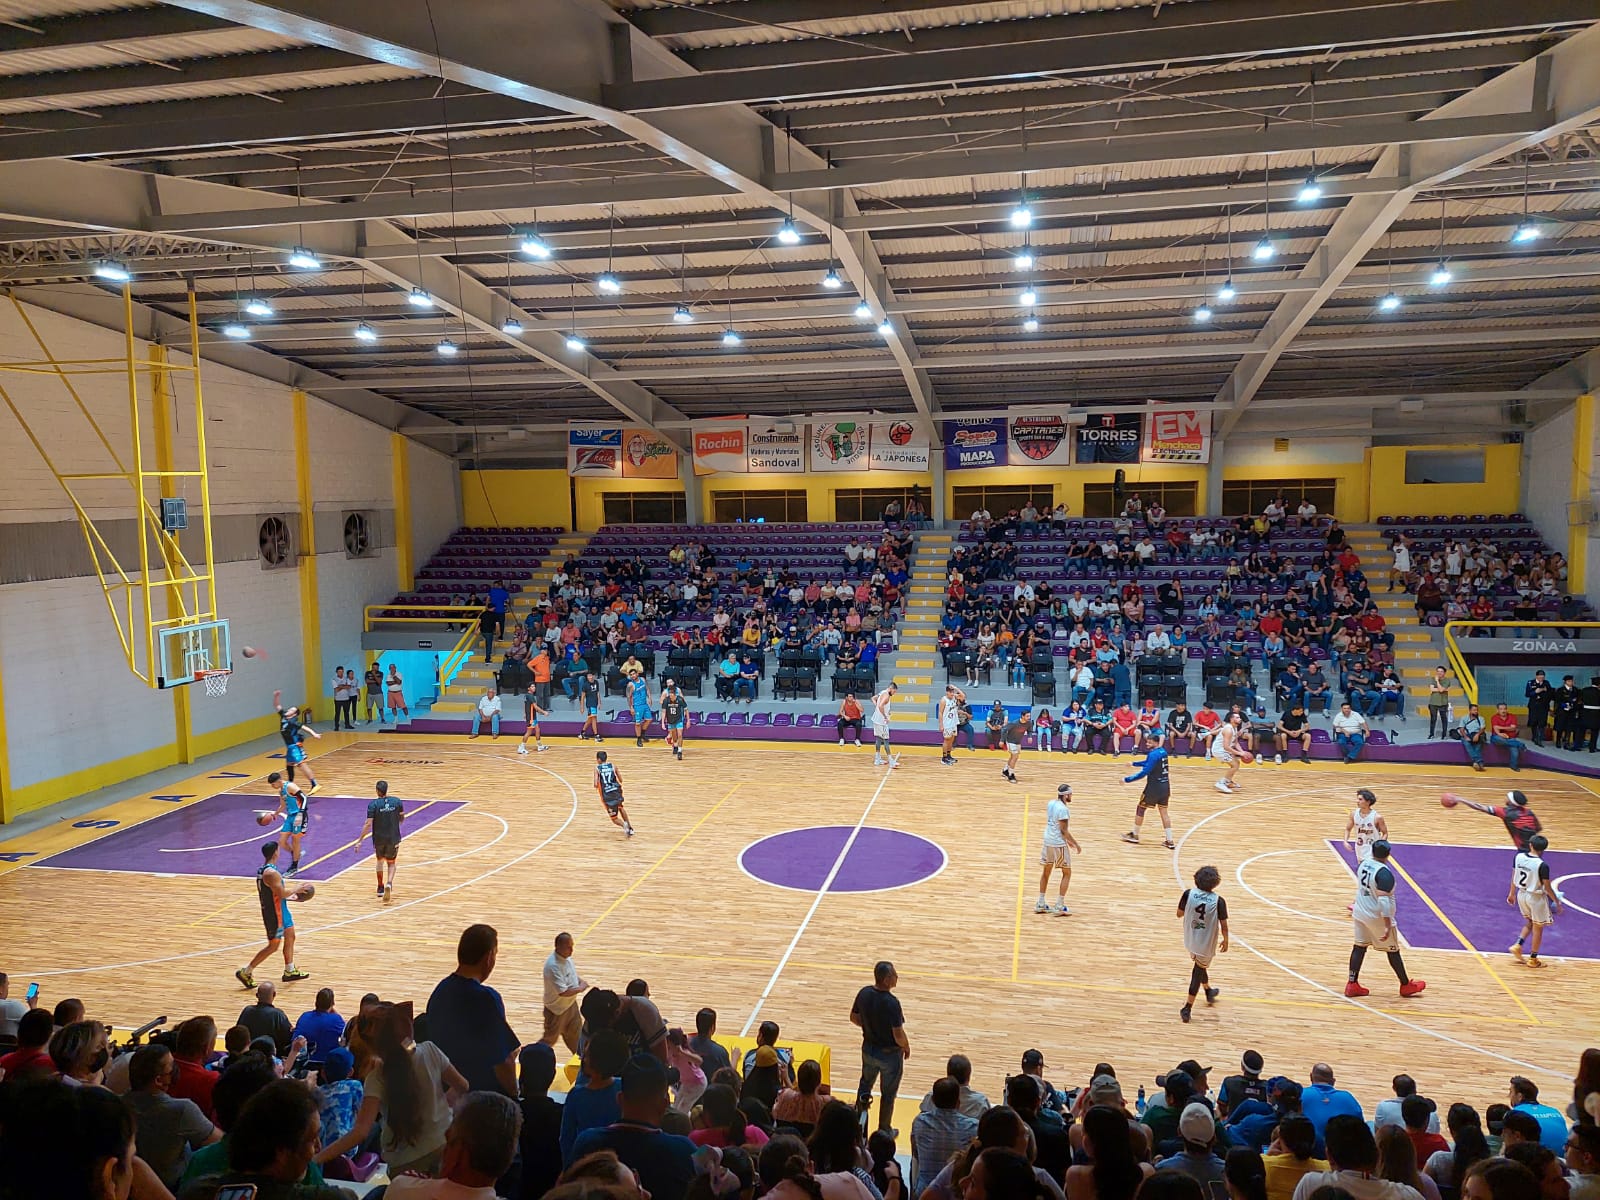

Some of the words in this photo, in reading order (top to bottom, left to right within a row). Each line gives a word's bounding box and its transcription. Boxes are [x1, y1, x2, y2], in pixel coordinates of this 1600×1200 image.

[1156, 413, 1199, 440] EM
[1080, 430, 1138, 441] TORRES
[699, 437, 740, 450] Rochin
[751, 458, 800, 467] Sandoval
[884, 455, 927, 463] JAPONESA
[960, 451, 995, 462] MAPA
[1512, 641, 1577, 652] ZONA-A
[601, 771, 612, 784] 17
[1361, 870, 1371, 888] 21
[1519, 871, 1527, 887] 2
[1195, 903, 1206, 920] 4
